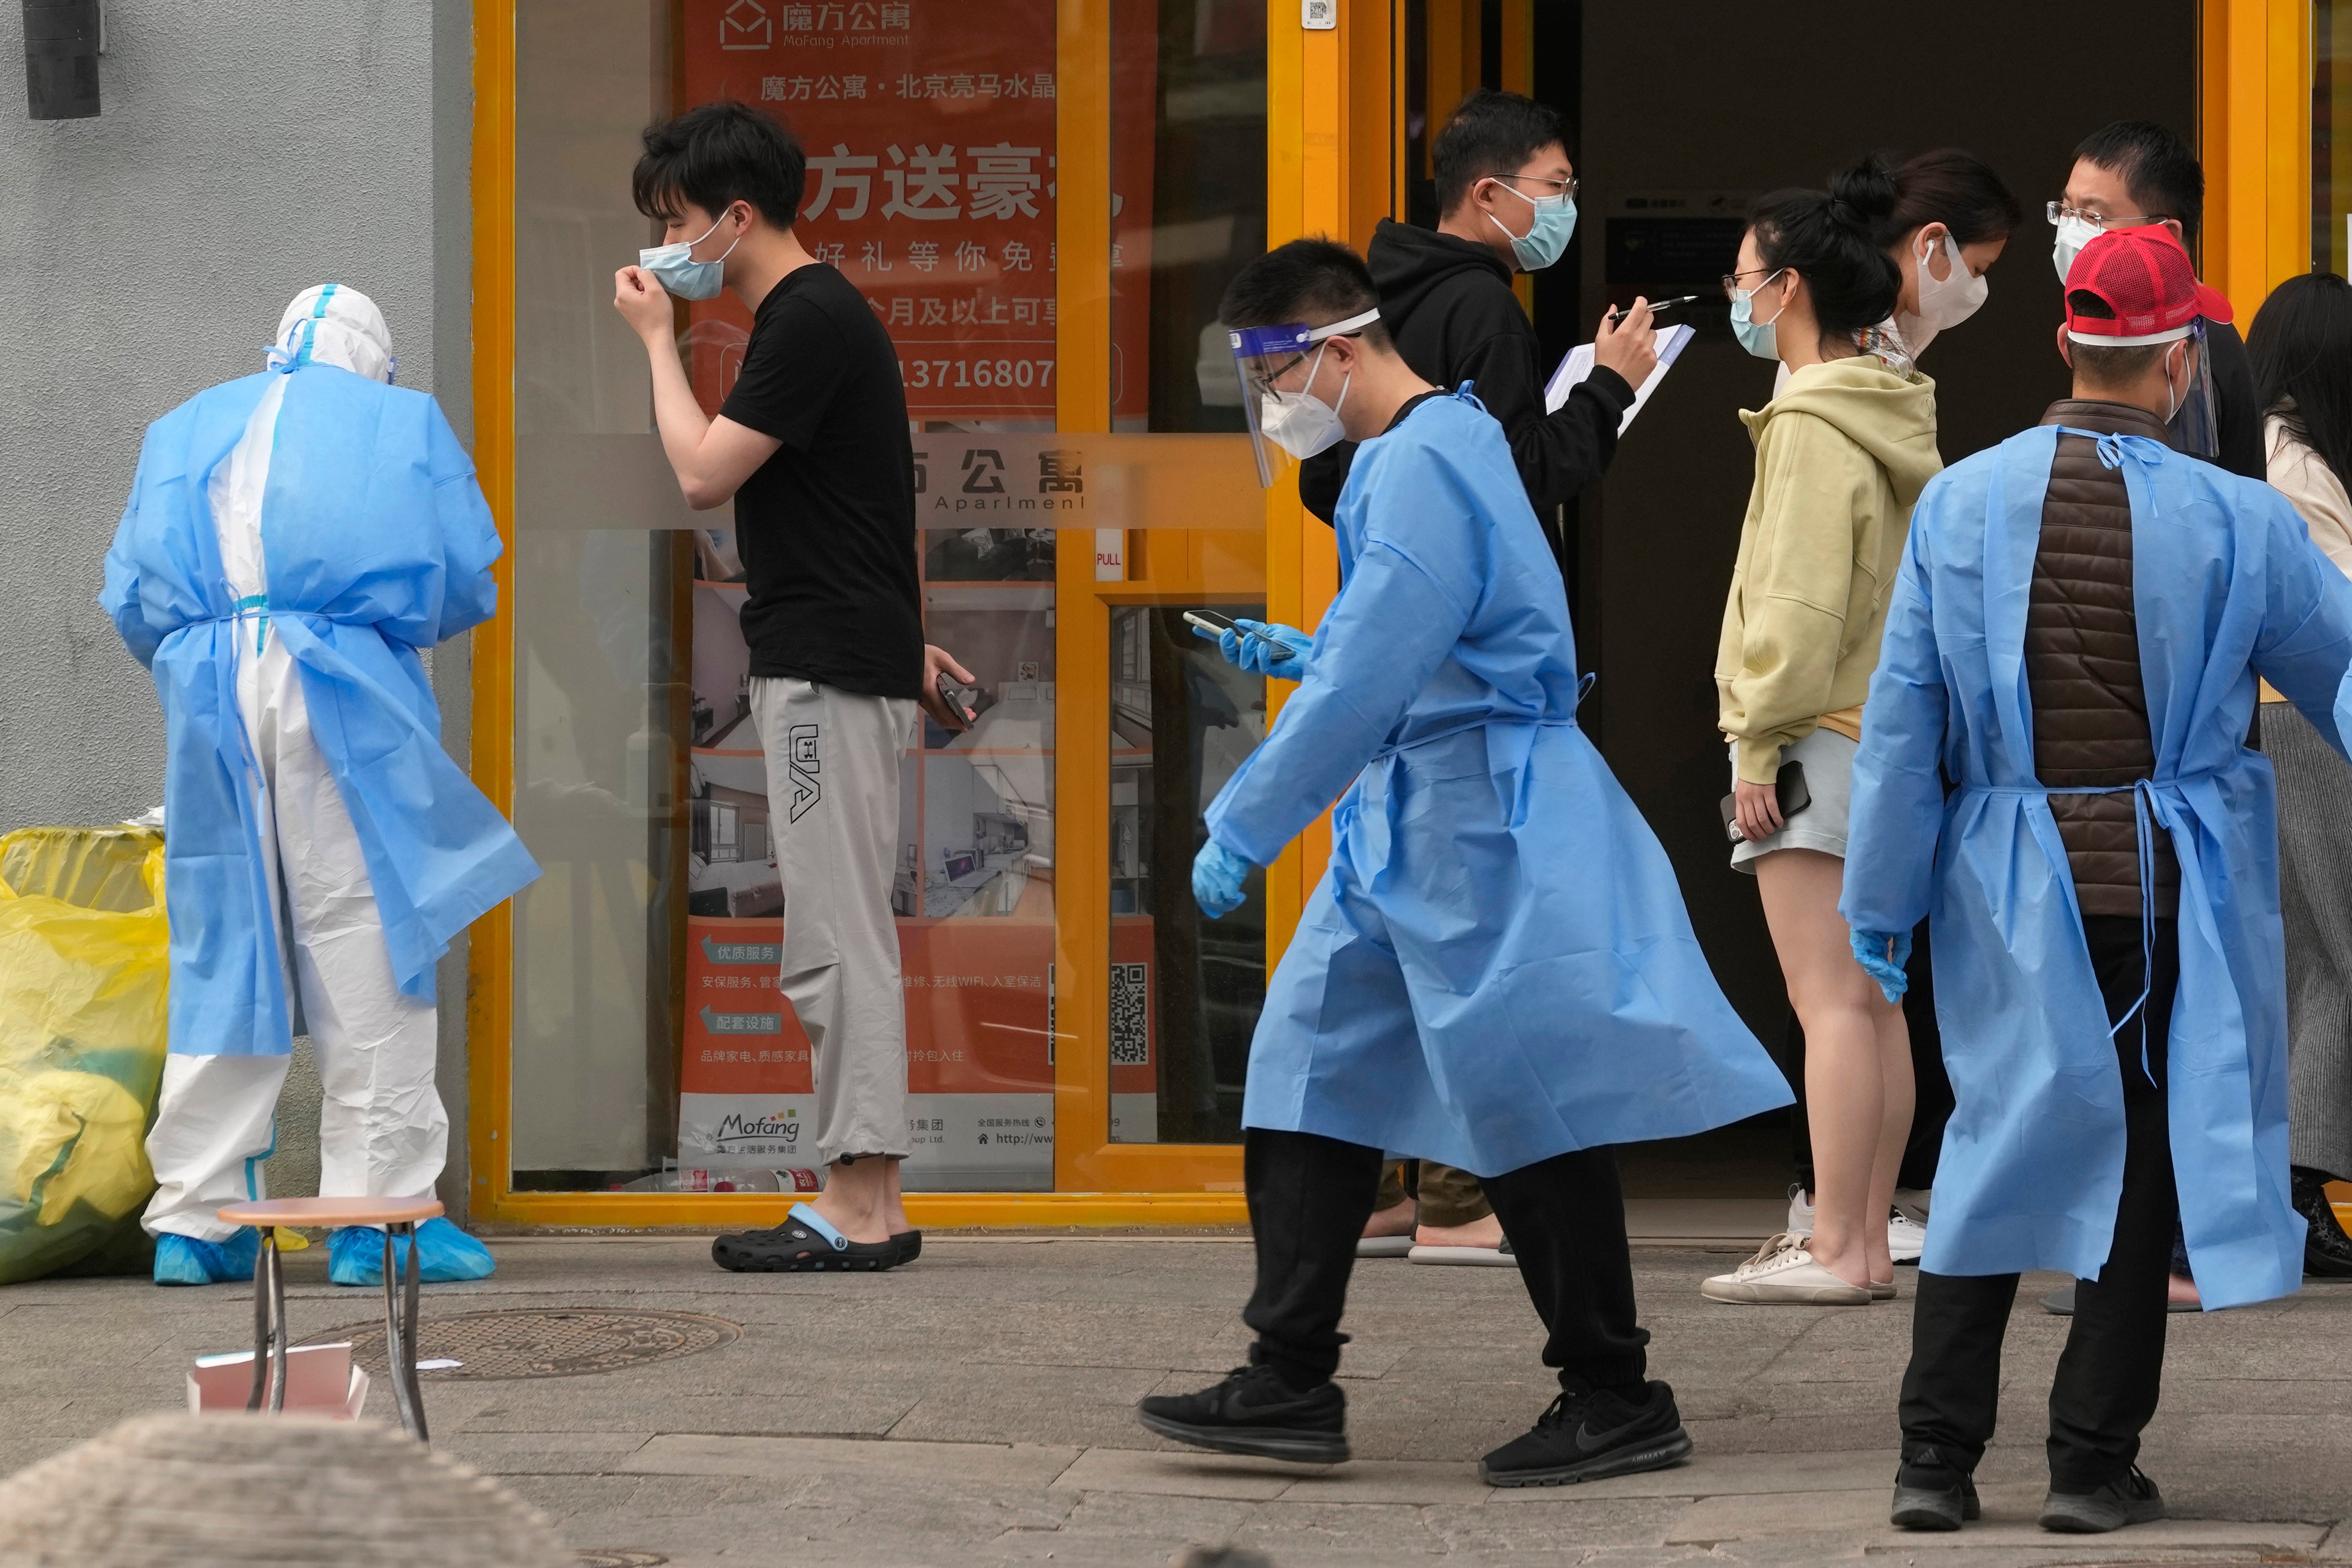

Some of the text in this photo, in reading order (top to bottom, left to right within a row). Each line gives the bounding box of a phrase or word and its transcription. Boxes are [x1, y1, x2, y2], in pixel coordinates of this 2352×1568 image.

[783, 2, 910, 31] 魔方公寓
[784, 34, 910, 48] MoFang Apartment
[796, 142, 1123, 222] 方送豪
[815, 240, 1123, 272] 好礼等你免
[1097, 553, 1121, 565] PULL
[717, 946, 774, 960] 优质服务
[716, 1016, 774, 1030] 配套设施
[718, 1114, 799, 1142] Mofang
[978, 1119, 1030, 1128] 全国服务热线
